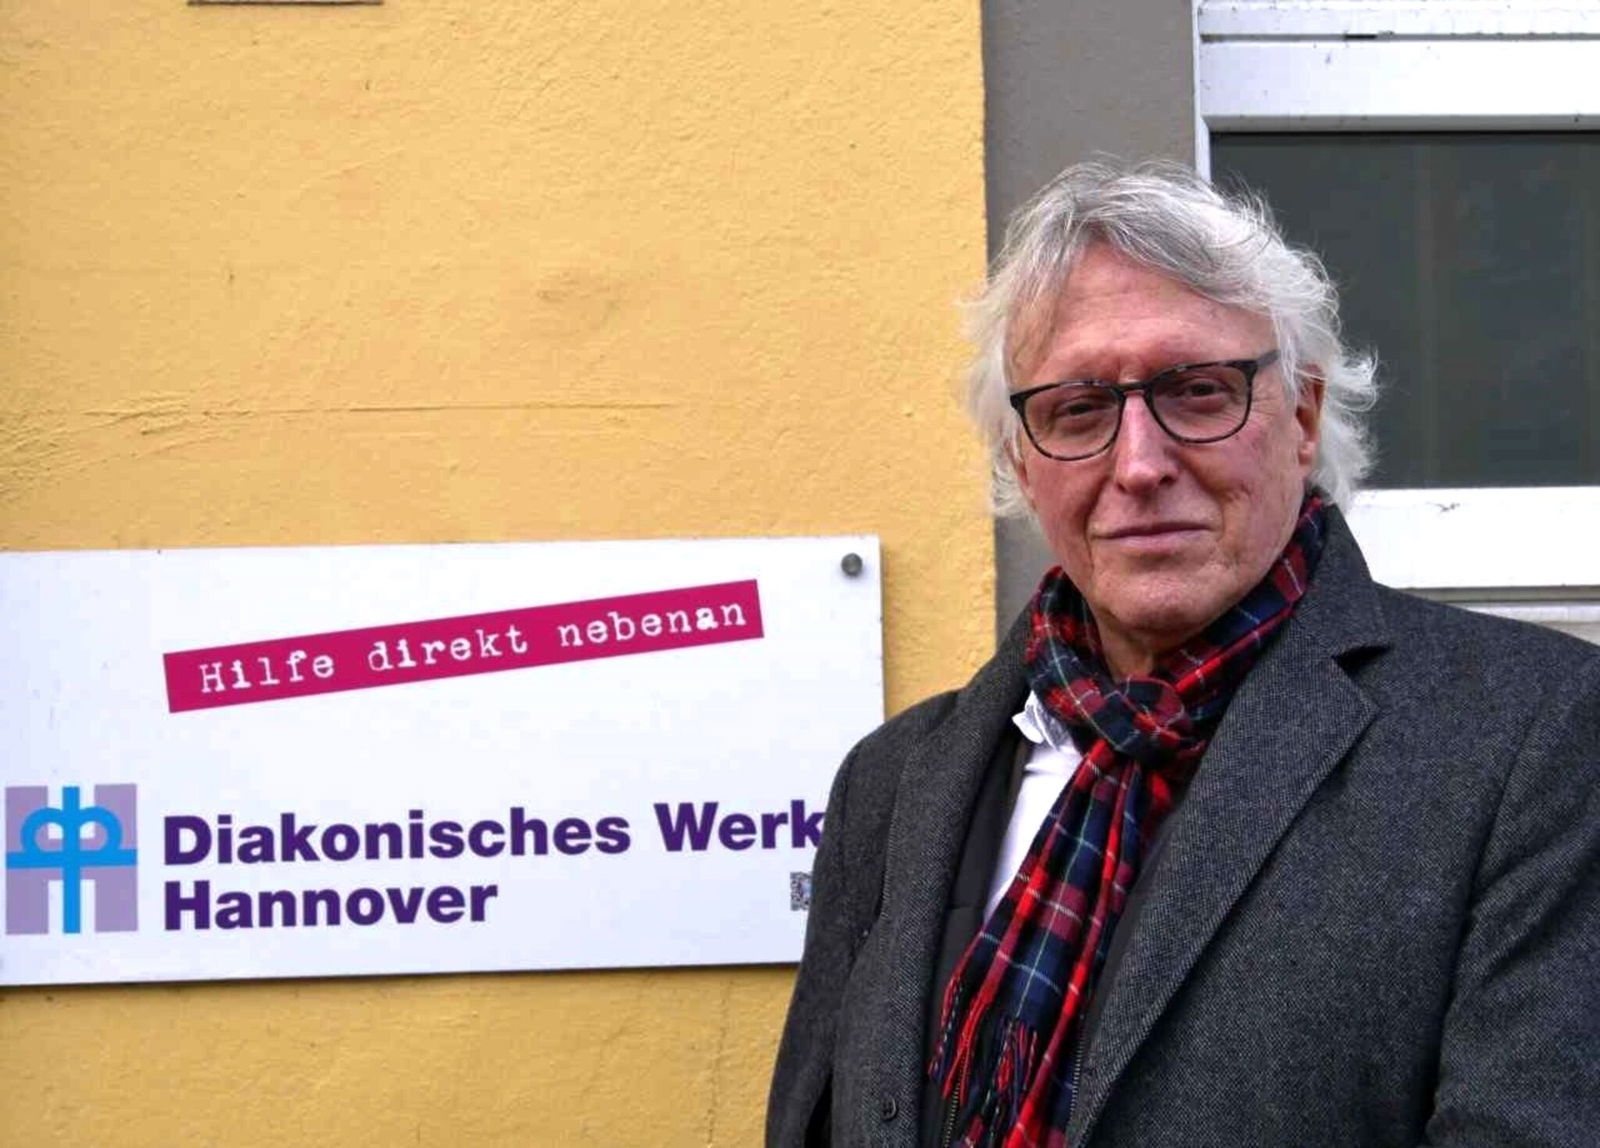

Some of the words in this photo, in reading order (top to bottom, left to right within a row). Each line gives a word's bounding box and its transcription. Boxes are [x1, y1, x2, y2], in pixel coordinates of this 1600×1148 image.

[199, 650, 334, 693] Hilfe
[368, 626, 528, 670] direkt
[558, 601, 746, 646] nebenan
[164, 807, 631, 866] Diakonisches
[654, 799, 825, 852] Werk
[165, 880, 498, 931] Hannover
